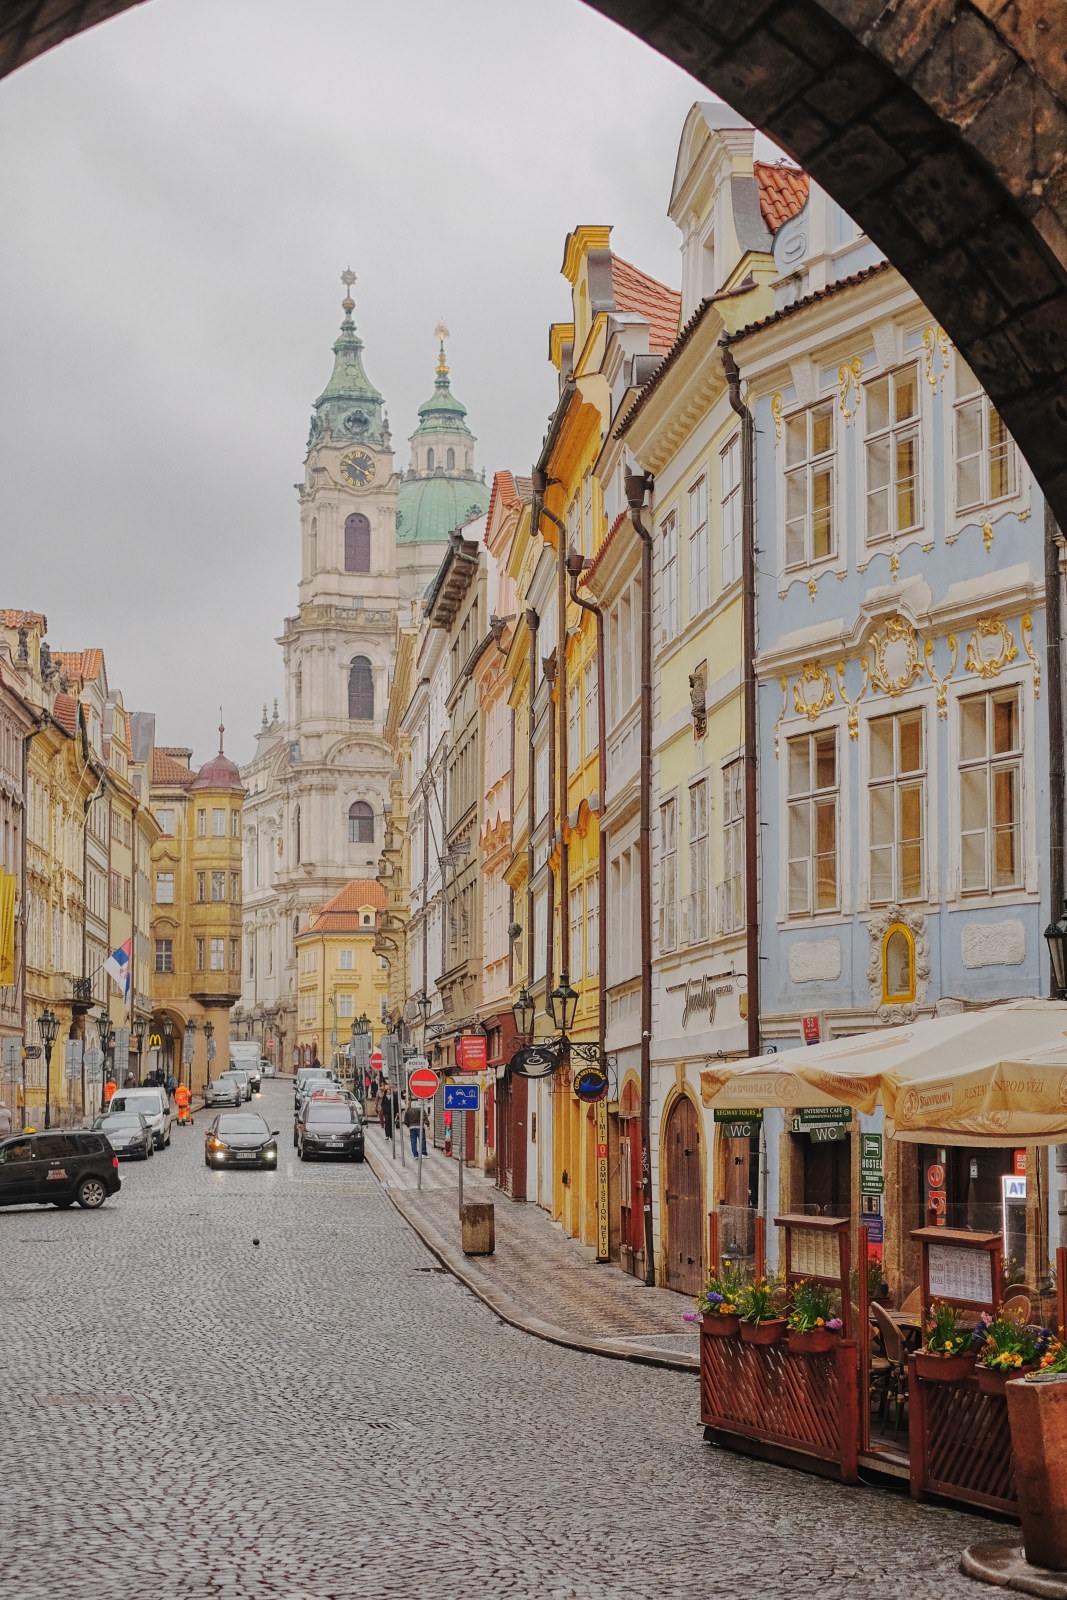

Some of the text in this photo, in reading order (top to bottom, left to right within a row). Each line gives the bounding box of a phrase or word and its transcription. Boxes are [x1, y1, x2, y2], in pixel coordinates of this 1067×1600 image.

[806, 1018, 814, 1028] 53
[730, 1125, 751, 1136] WC
[816, 1128, 837, 1140] WC
[862, 1159, 882, 1168] HOSTEL
